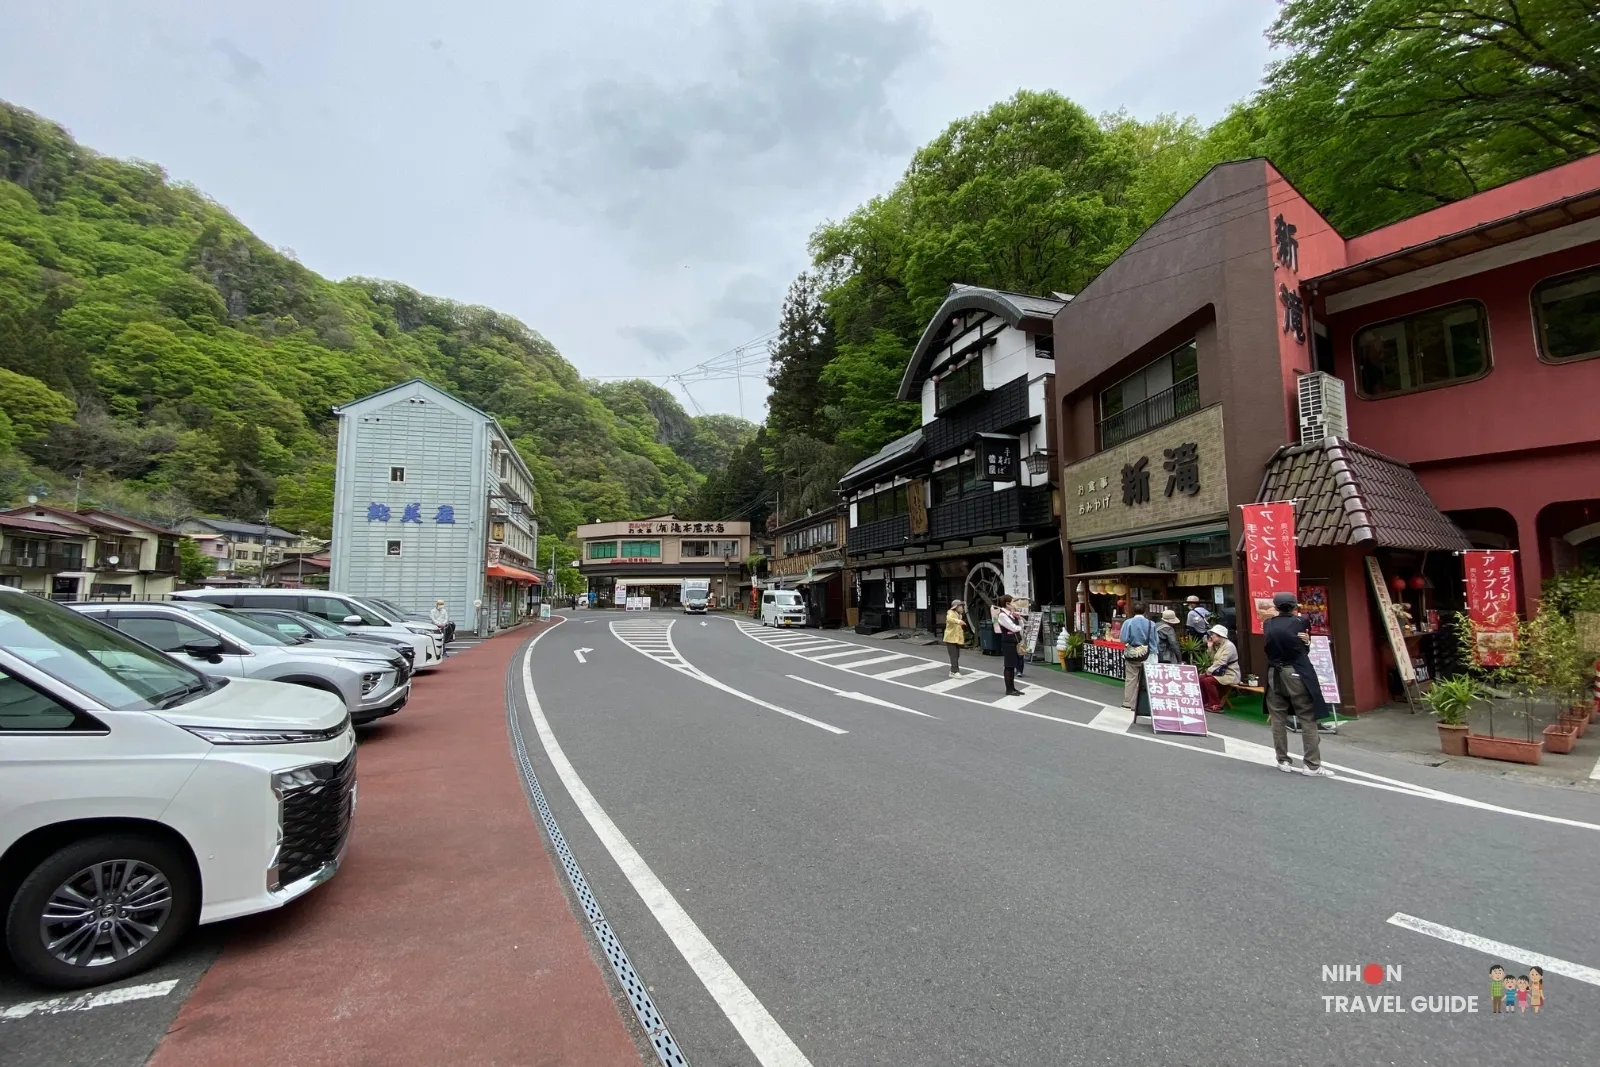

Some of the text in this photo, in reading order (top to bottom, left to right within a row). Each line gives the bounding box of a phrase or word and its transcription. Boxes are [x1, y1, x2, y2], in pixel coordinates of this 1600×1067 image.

[1121, 442, 1201, 507] 新滝
[1077, 476, 1109, 496] お食事
[1078, 493, 1112, 515] おみやげ
[1499, 566, 1511, 601] 手づくり
[1146, 664, 1195, 681] 新滝で
[1149, 680, 1200, 697] お食事
[1152, 697, 1180, 712] 無料
[1181, 697, 1200, 706] の方
